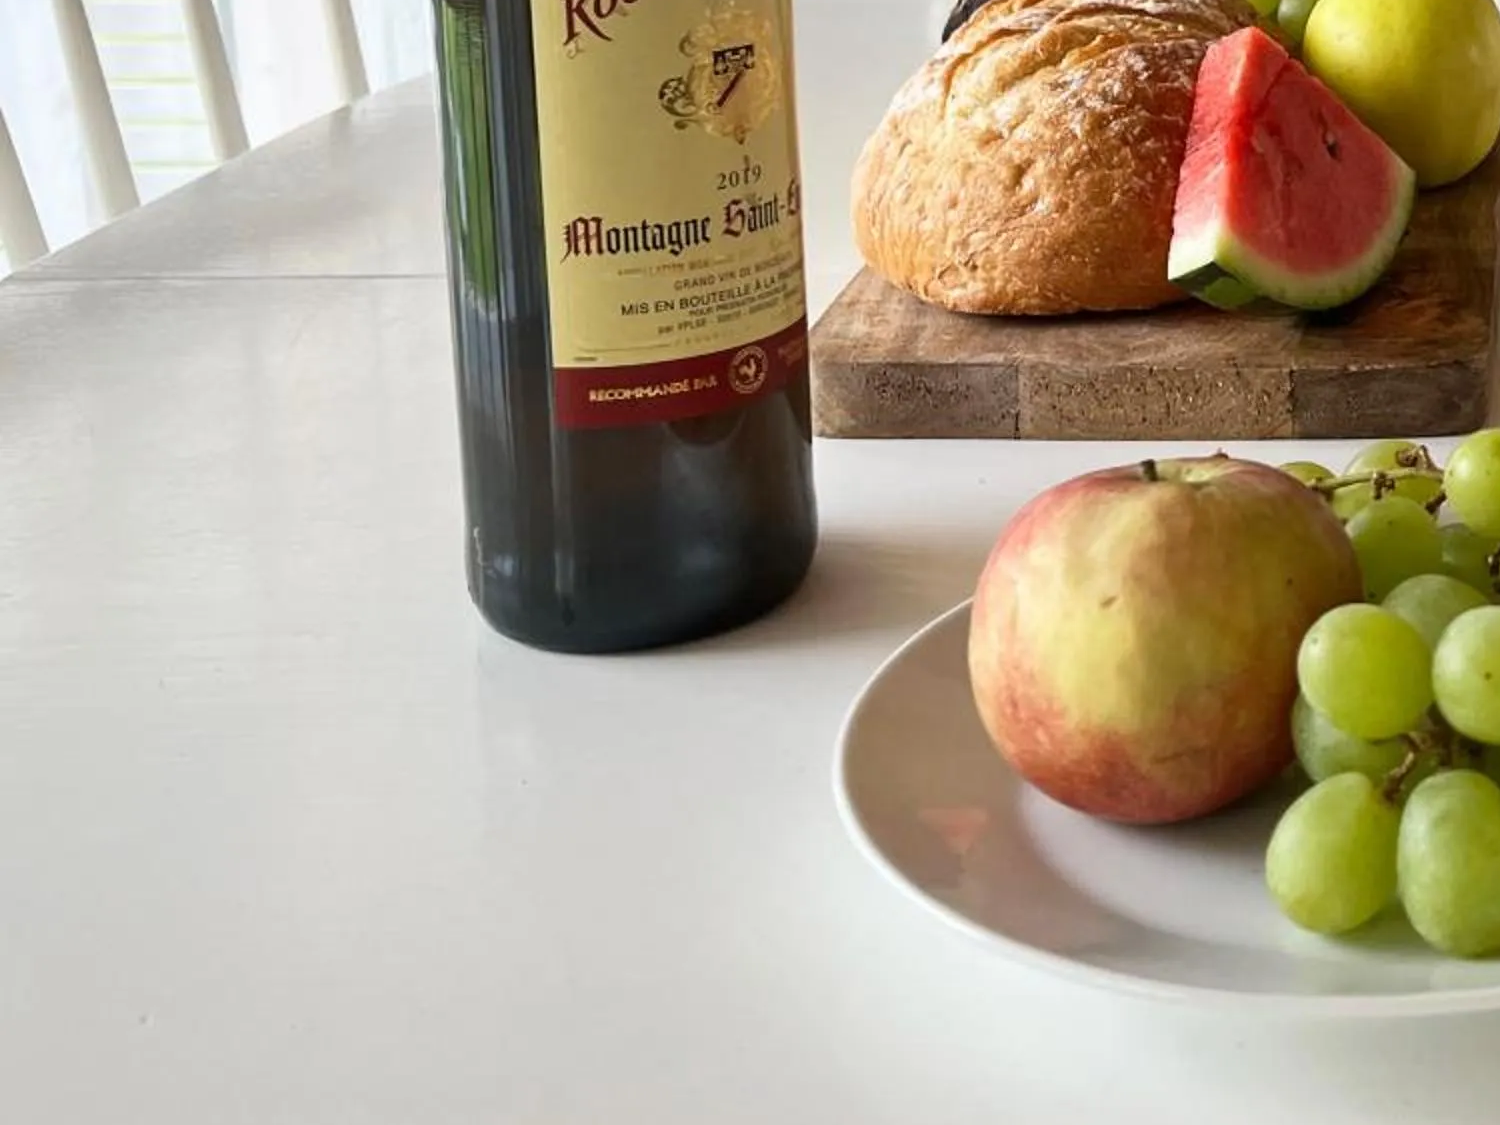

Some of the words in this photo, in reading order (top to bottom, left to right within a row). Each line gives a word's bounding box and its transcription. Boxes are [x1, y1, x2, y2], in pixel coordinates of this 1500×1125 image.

[716, 164, 762, 190] 2019
[560, 215, 712, 265] Montagne
[674, 276, 716, 291] GRAND
[620, 301, 650, 317] MIS
[654, 298, 676, 313] EN
[679, 283, 751, 309] BOUTEILLE
[588, 378, 690, 403] RECOMMANDÉ
